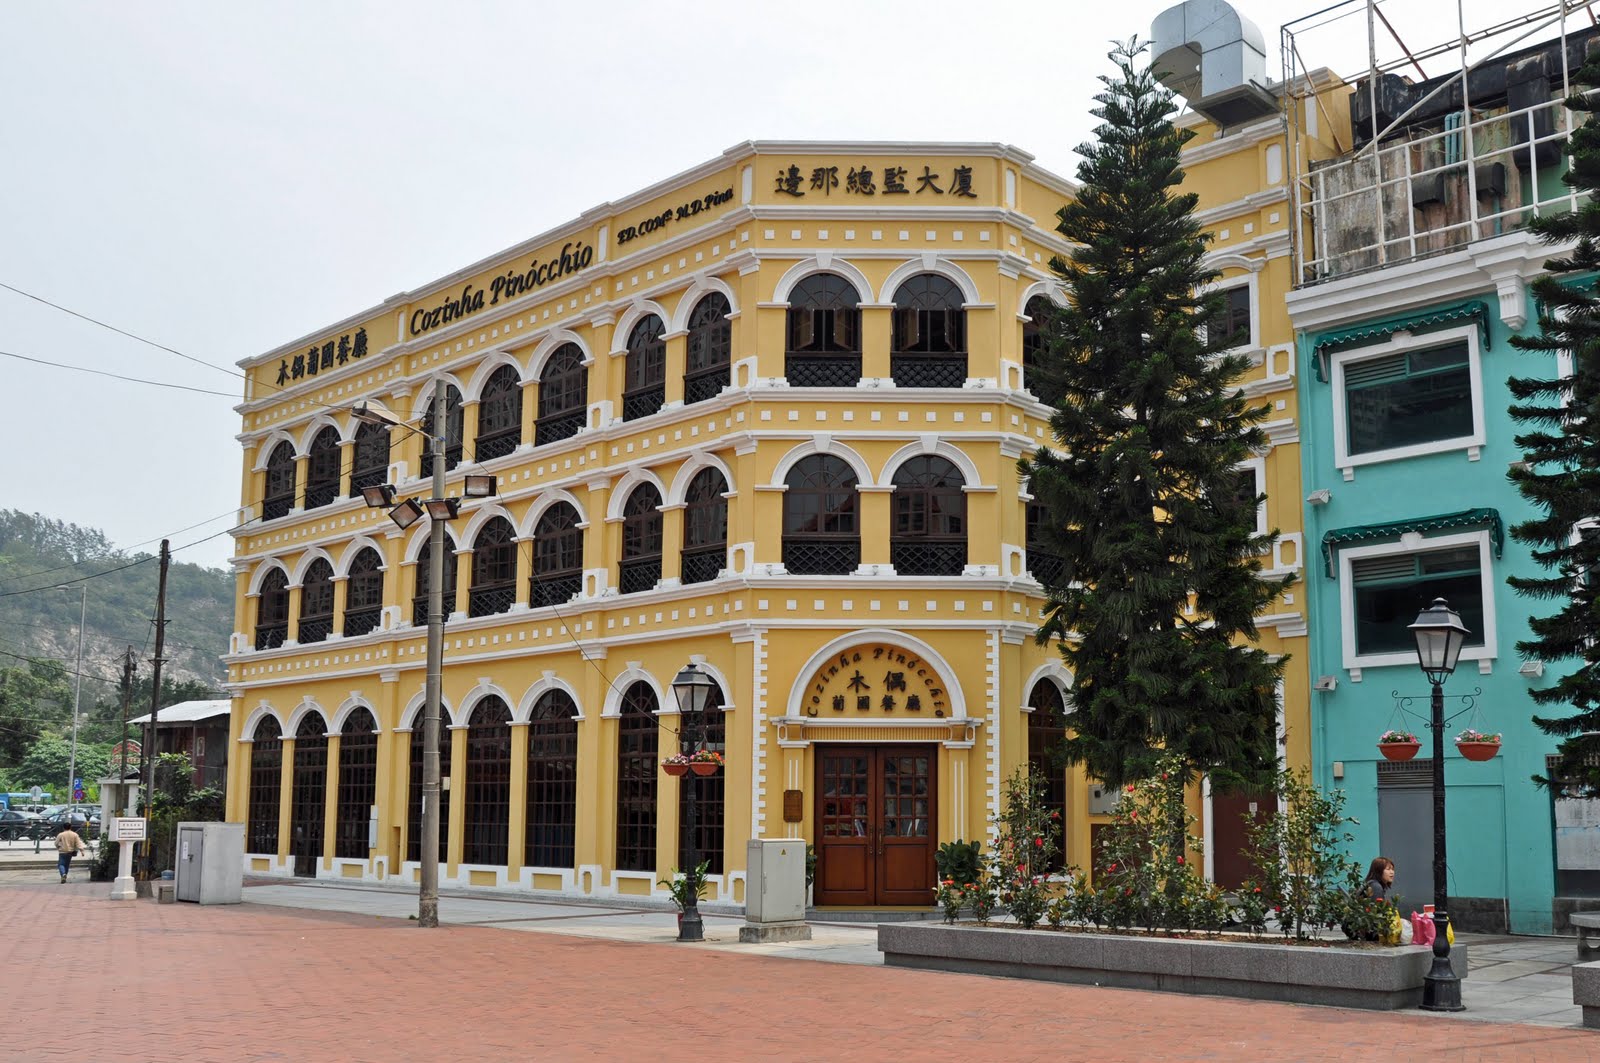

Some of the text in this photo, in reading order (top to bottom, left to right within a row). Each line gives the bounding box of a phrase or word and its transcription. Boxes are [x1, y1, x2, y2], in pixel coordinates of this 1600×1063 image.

[774, 164, 978, 198] 邊那總監大廈
[409, 241, 593, 335] Cozinha Pinócchio
[807, 647, 944, 717] Cozinha Pinócchio
[847, 670, 906, 692] 木偶
